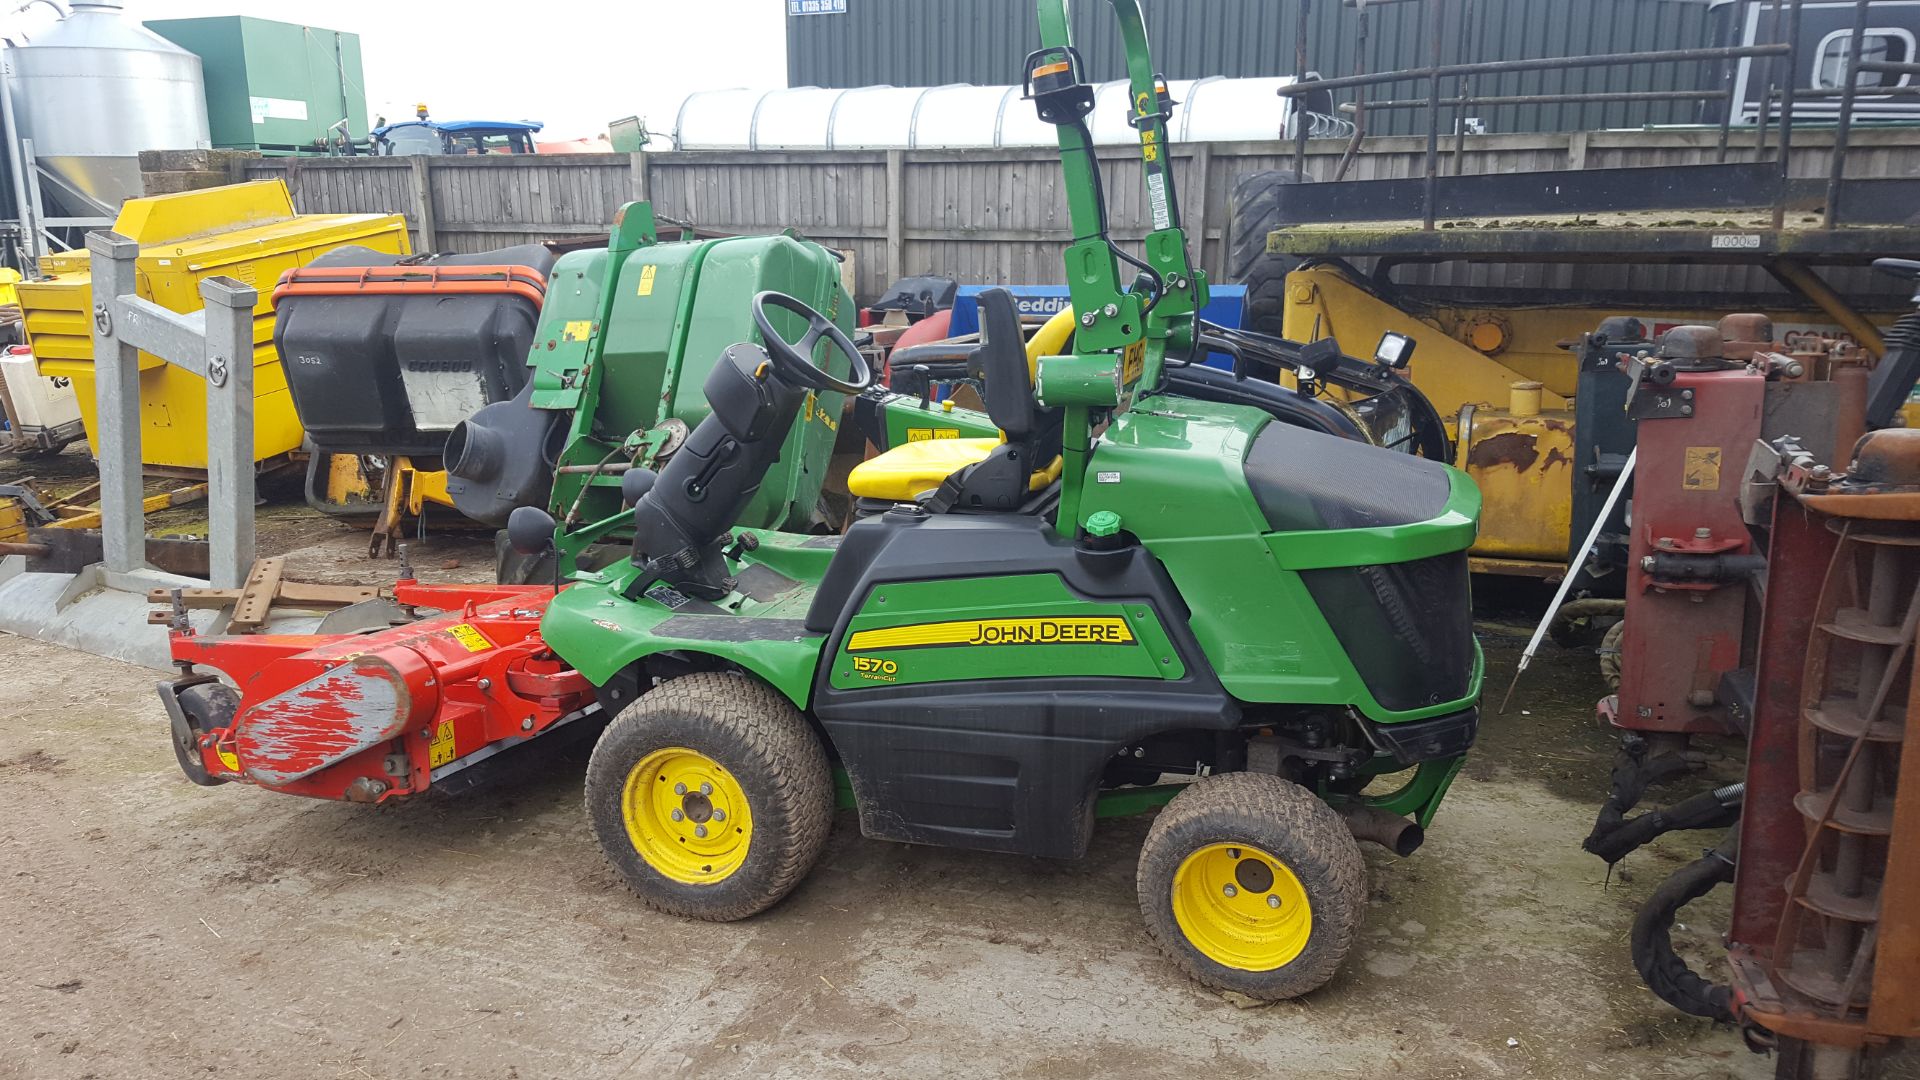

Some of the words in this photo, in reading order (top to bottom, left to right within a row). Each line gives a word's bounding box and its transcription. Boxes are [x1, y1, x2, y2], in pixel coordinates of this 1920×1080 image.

[1013, 297, 1072, 312] eddi
[969, 623, 1034, 642] JOHN
[1040, 621, 1121, 640] DEERE
[853, 656, 898, 674] 1570
